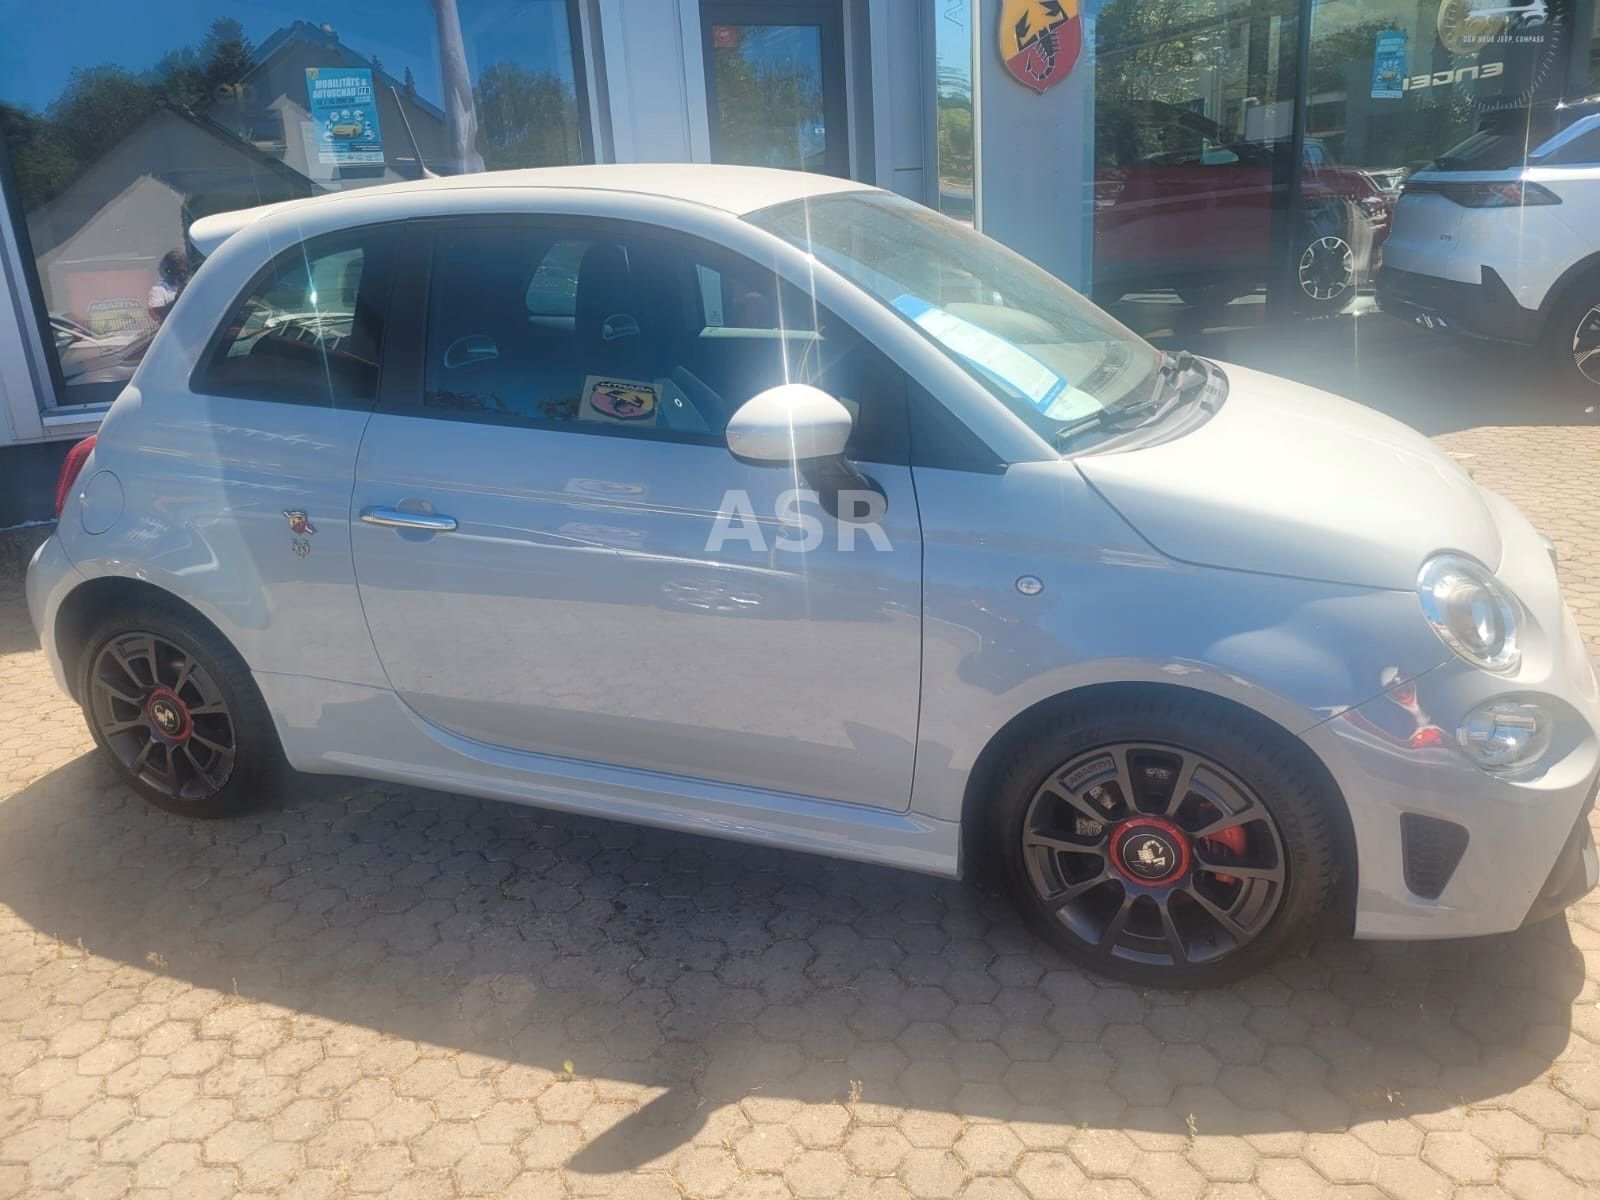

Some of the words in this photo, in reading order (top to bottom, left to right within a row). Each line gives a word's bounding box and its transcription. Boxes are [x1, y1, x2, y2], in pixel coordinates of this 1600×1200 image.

[1515, 35, 1545, 43] COMPASS
[315, 76, 360, 89] MOBILITÄTS
[312, 87, 356, 99] AUTOSCHAU
